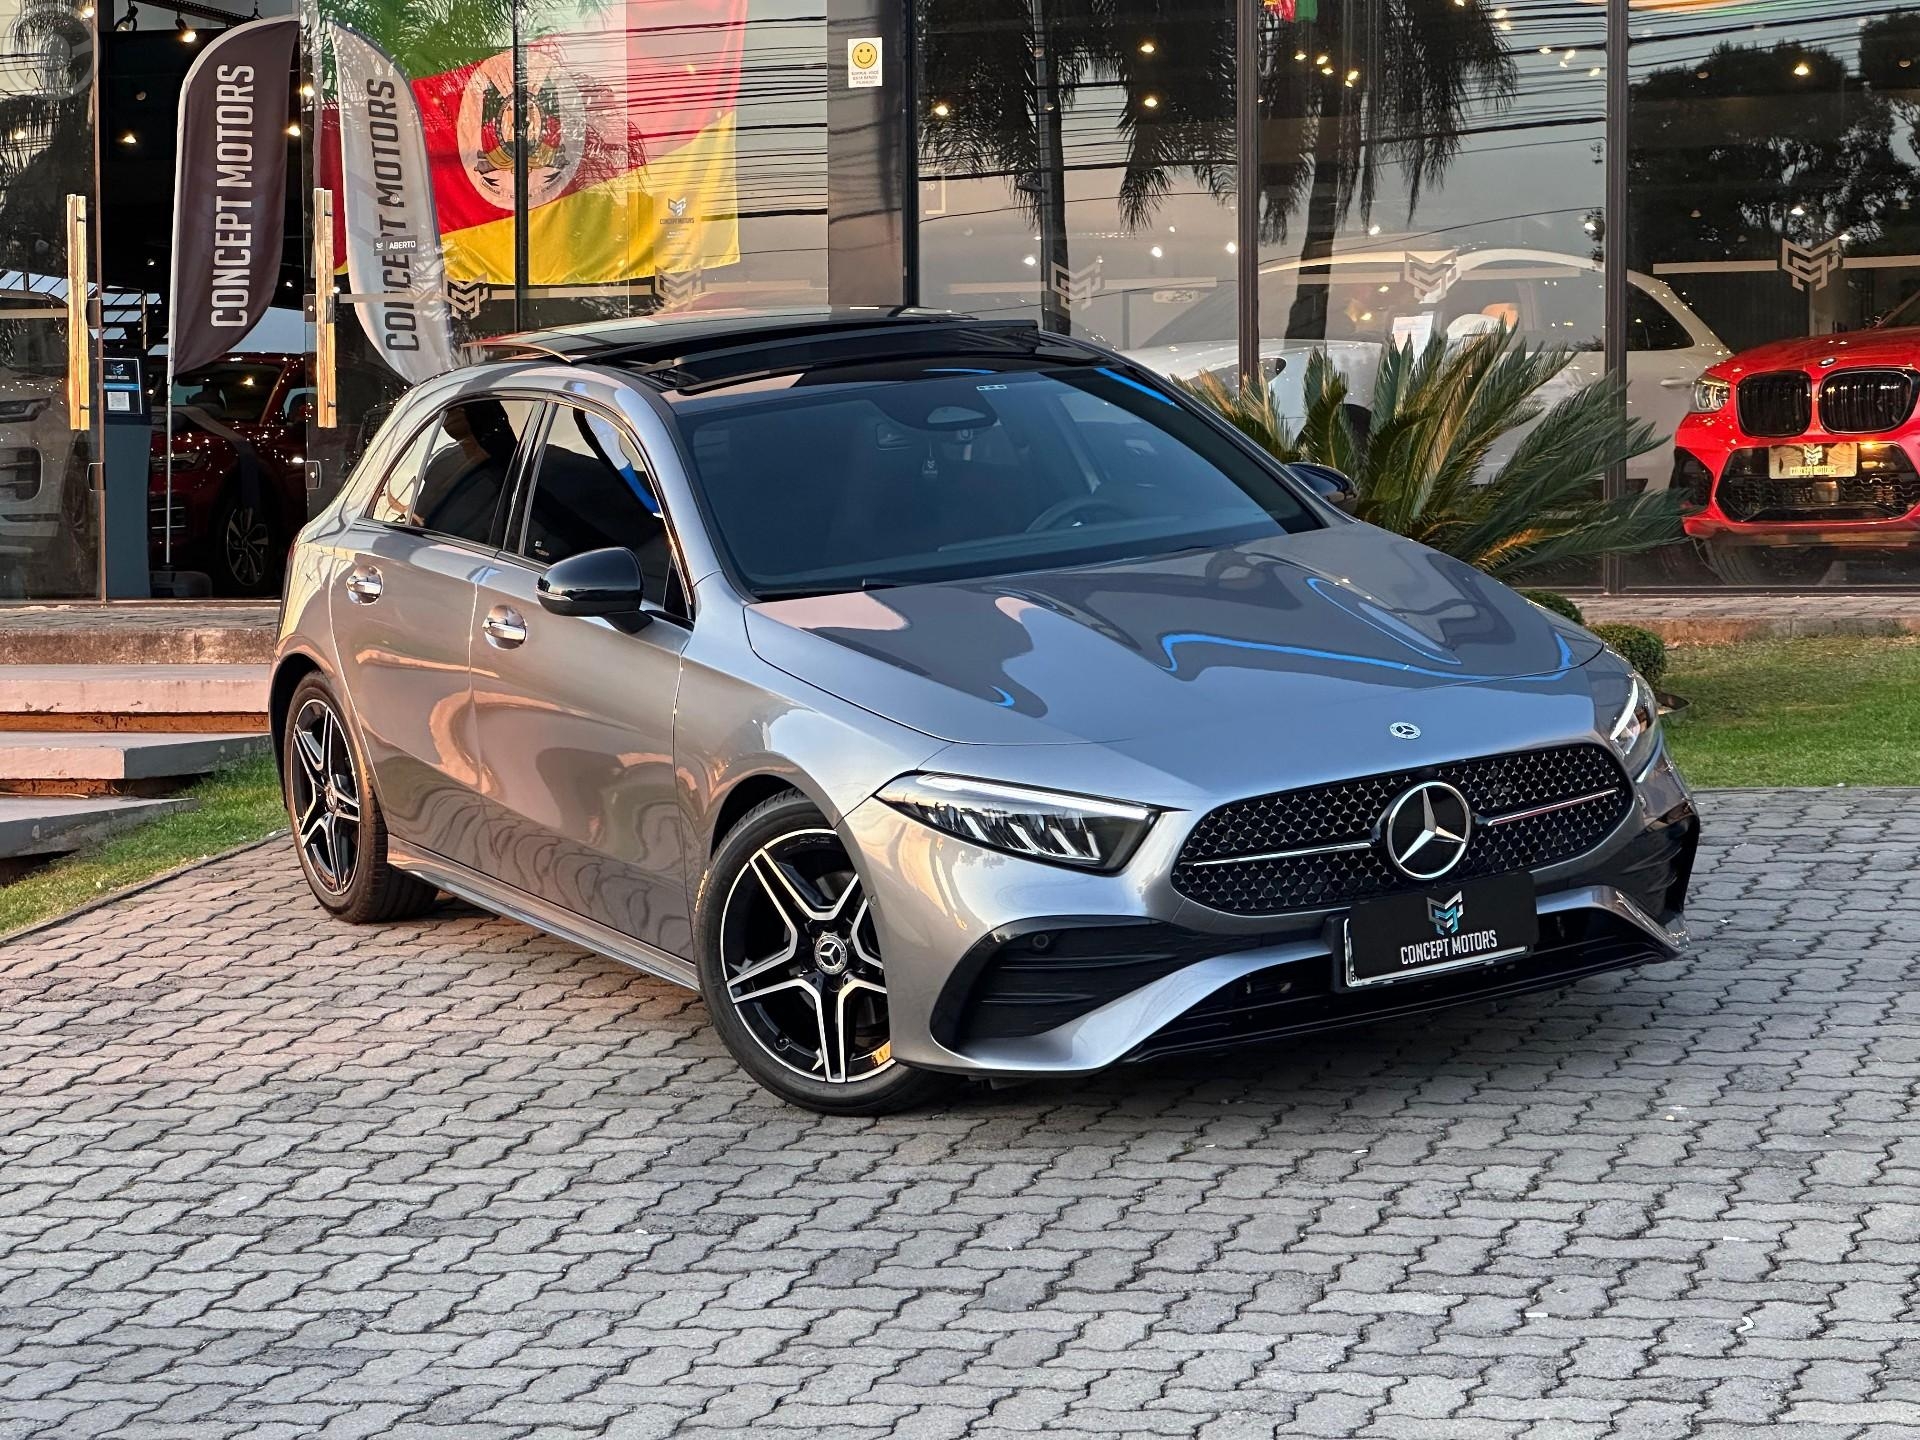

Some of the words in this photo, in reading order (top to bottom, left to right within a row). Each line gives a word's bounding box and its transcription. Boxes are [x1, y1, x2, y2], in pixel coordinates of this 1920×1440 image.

[216, 64, 255, 188] MOTORS
[366, 78, 405, 208] MOTORS
[210, 195, 252, 328] CONCEPT
[388, 240, 416, 250] ABERTO
[1400, 938, 1449, 965] CONCEPT
[1452, 929, 1498, 955] MOTORS
